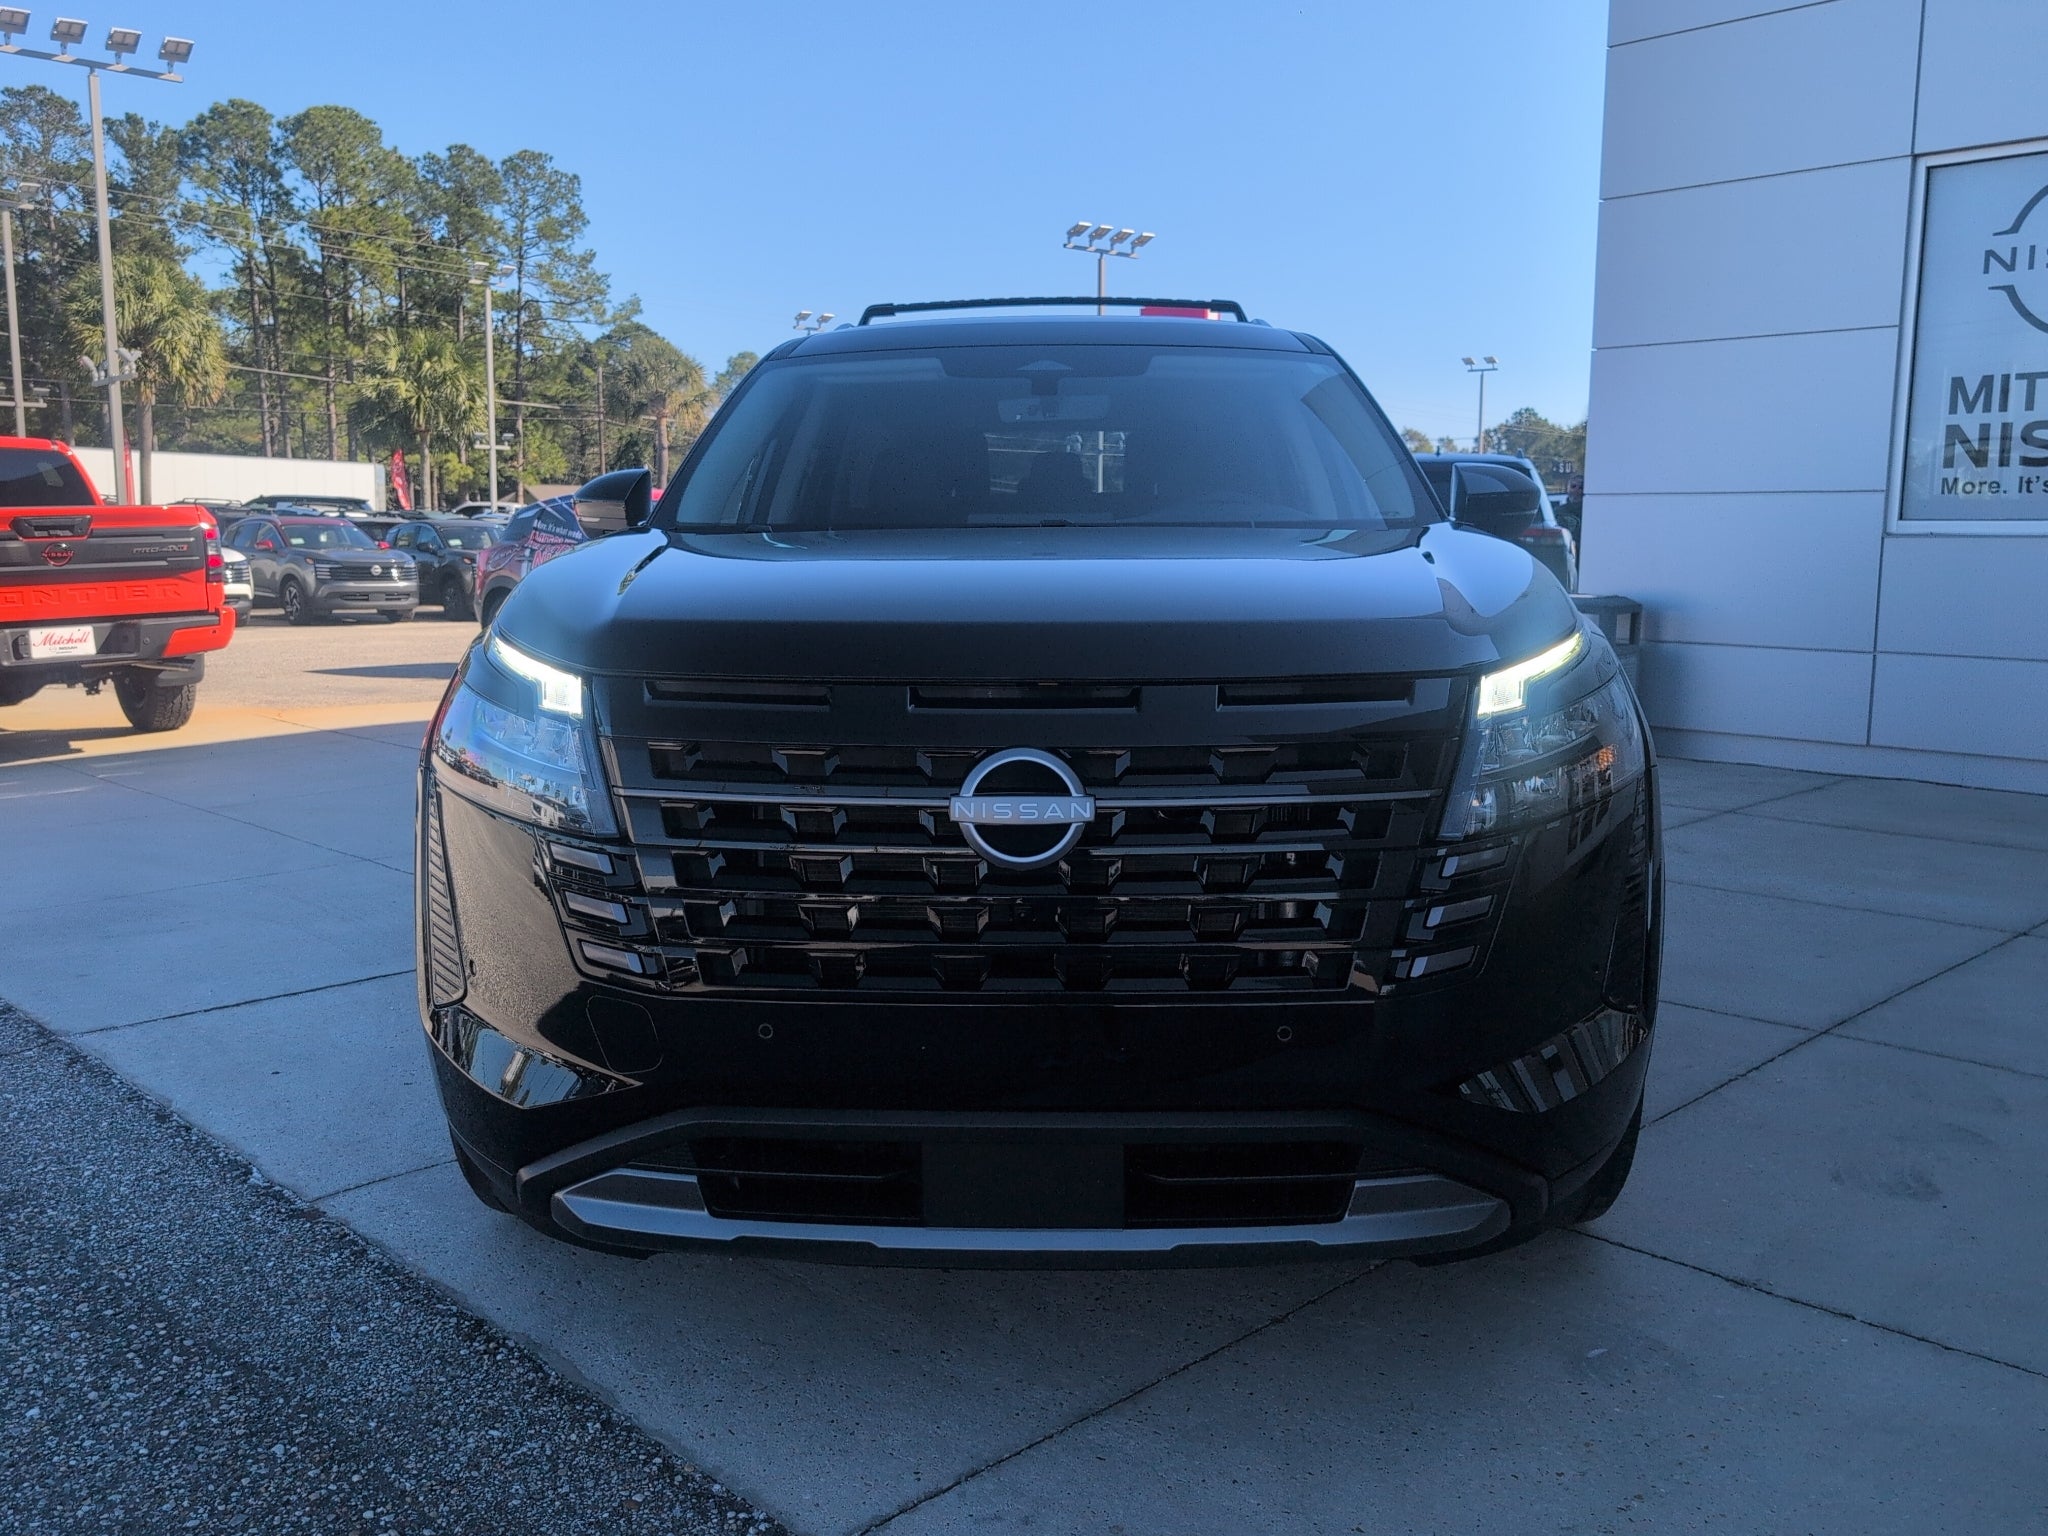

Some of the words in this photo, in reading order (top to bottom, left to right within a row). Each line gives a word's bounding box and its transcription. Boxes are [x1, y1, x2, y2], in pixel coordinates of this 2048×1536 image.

[1983, 244, 2048, 275] NI
[1948, 371, 2048, 415] MIT
[1941, 476, 2008, 495] More.
[33, 631, 91, 647] Mitchell
[955, 801, 1091, 819] NISSAN
